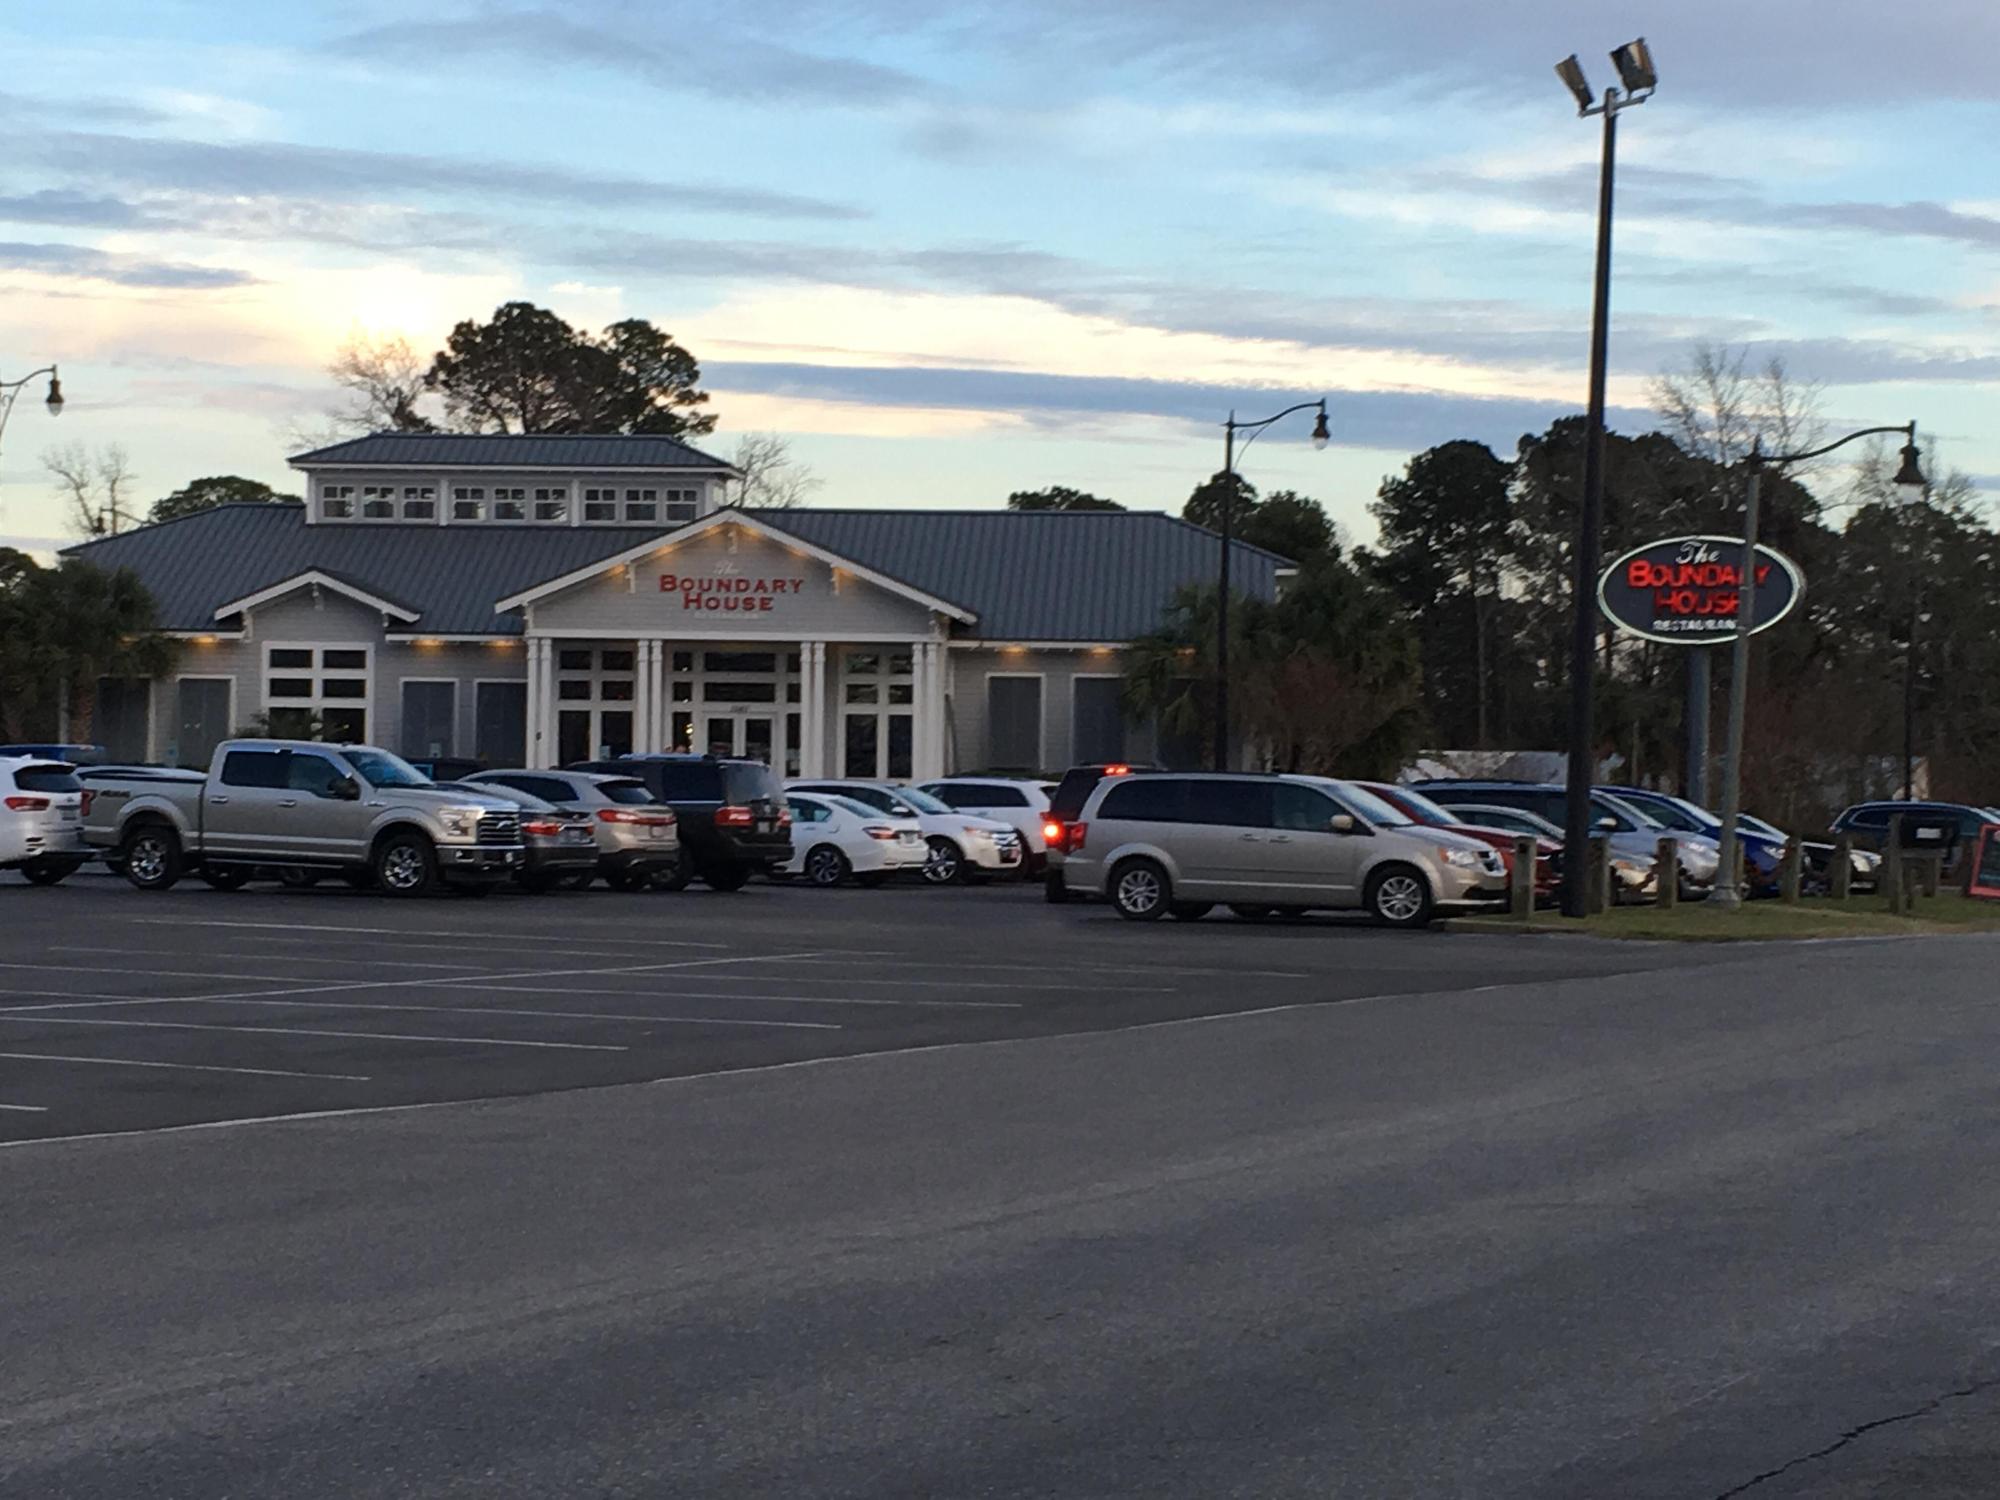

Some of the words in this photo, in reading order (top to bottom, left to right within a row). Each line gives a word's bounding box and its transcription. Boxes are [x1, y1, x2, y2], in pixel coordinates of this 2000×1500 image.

[1676, 541, 1721, 564] The
[659, 574, 804, 593] BOUNDARY
[683, 592, 774, 611] HOUSE
[1652, 619, 1739, 632] RESTAURAN
